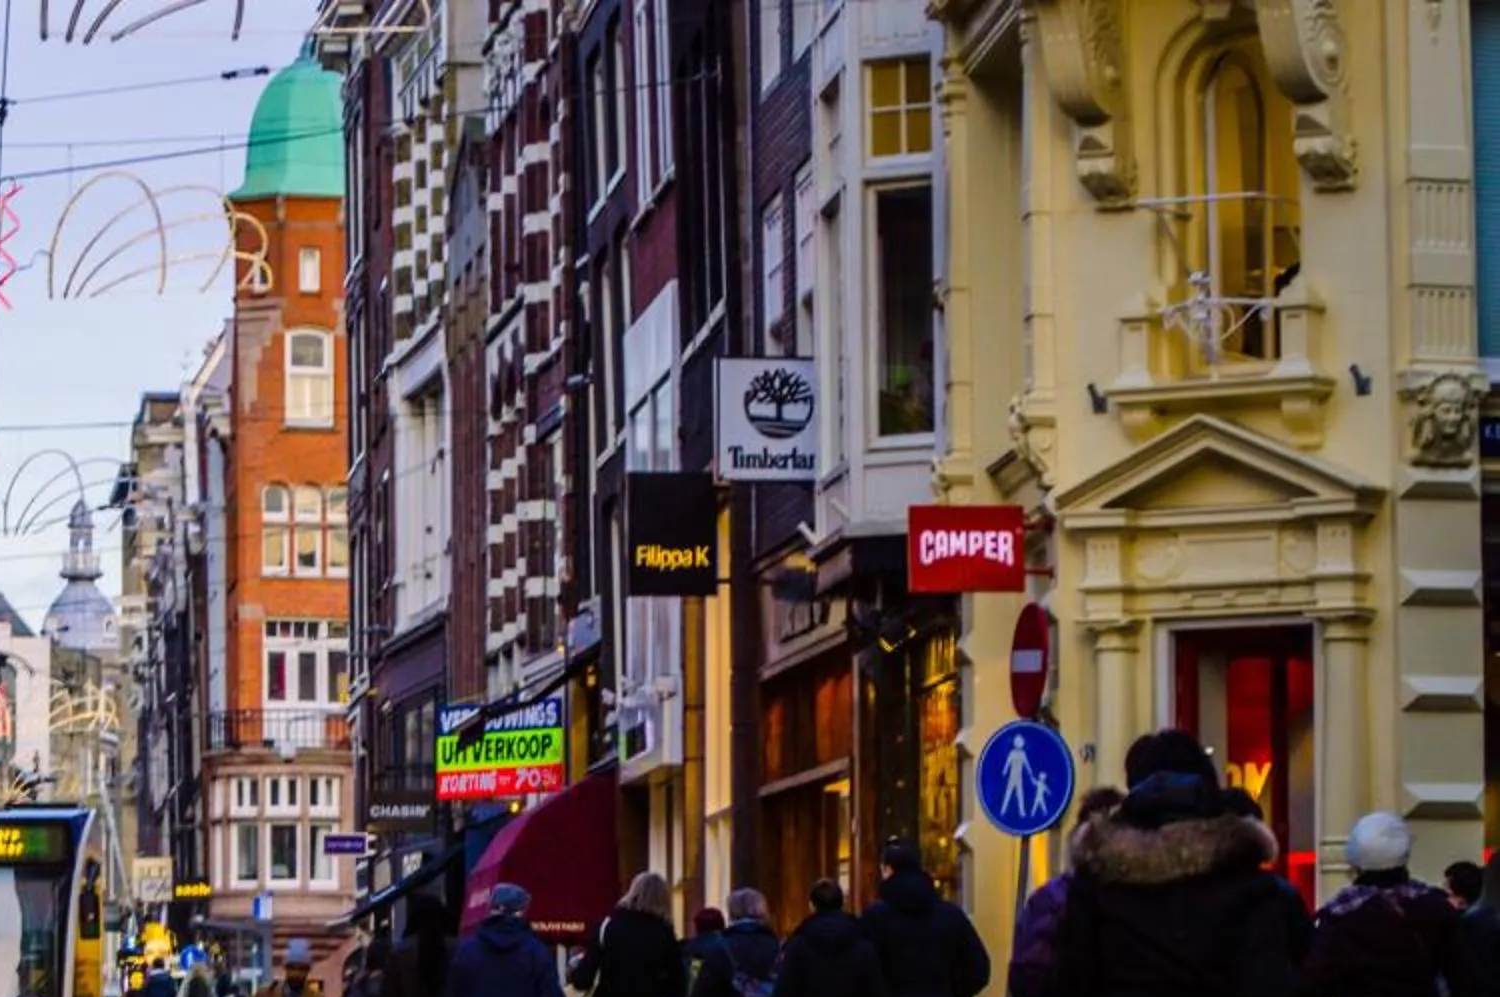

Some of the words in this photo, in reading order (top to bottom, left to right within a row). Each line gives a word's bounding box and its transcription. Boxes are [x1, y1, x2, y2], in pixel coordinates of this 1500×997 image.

[635, 544, 693, 571] Filippa
[695, 544, 710, 568] K
[920, 528, 1015, 567] CAMPER
